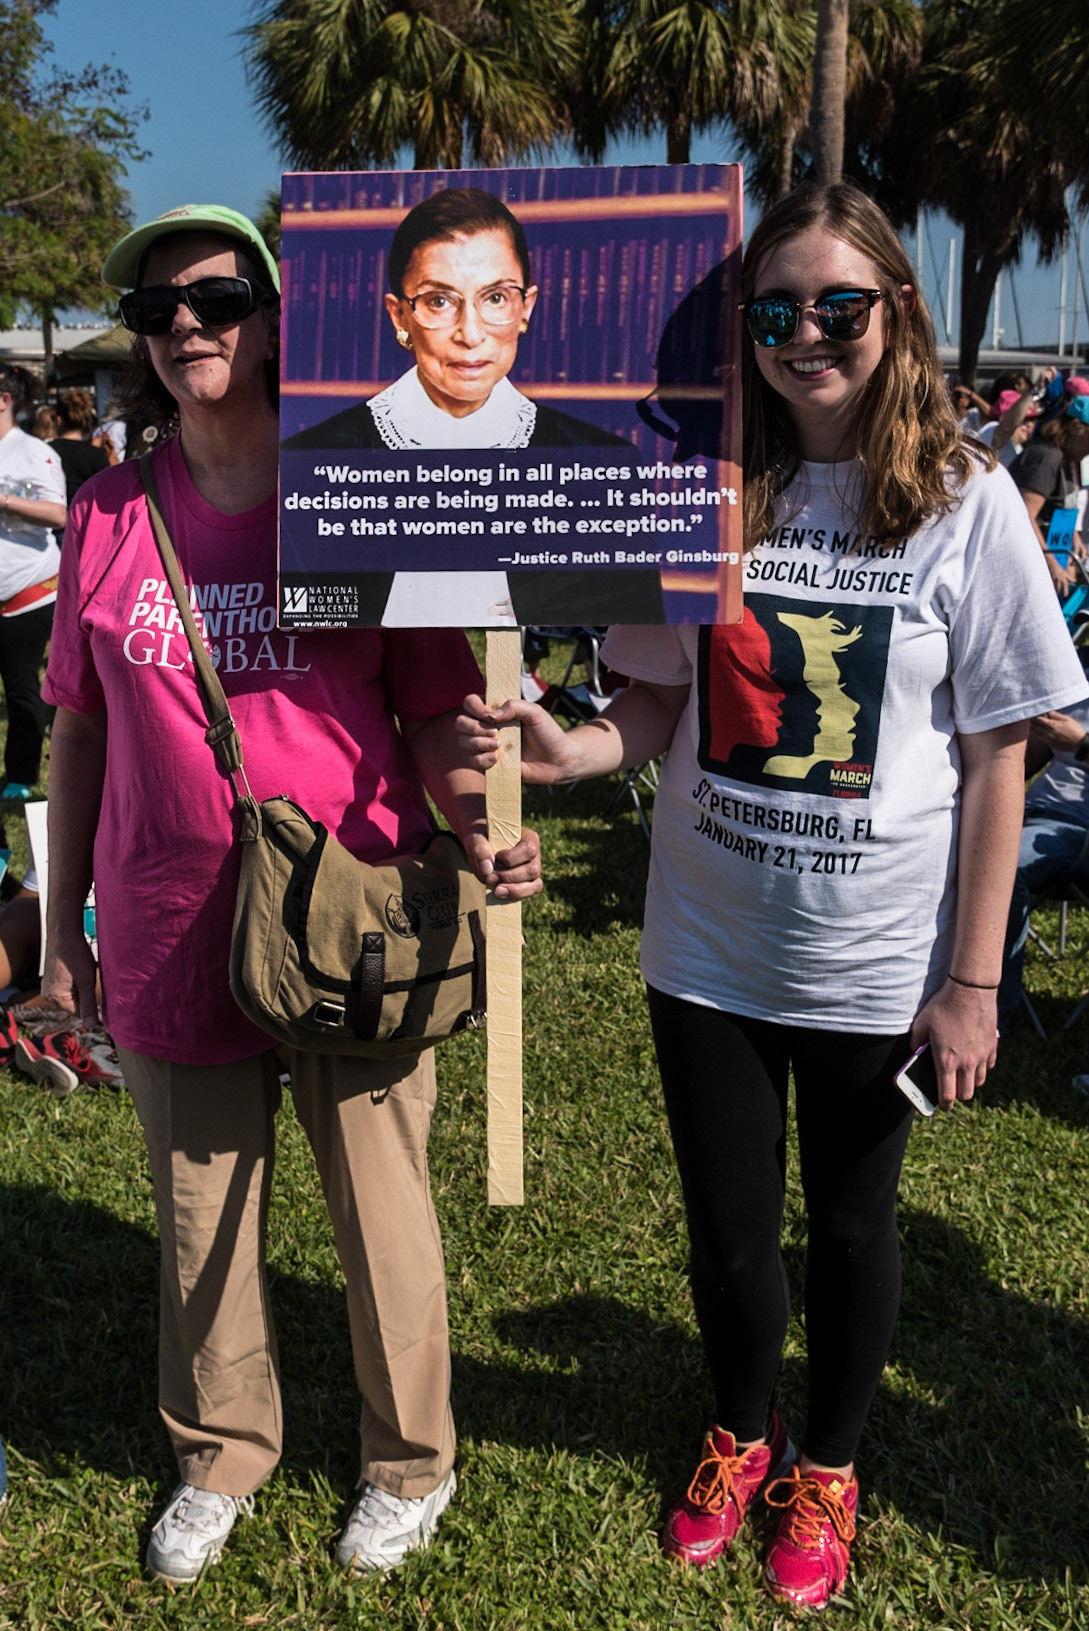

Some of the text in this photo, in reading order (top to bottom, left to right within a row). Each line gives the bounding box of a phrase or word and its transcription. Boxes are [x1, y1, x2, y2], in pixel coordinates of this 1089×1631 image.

[313, 462, 707, 486] “Women belong in all places where
[284, 491, 389, 510] decisions
[394, 495, 430, 509] are
[436, 490, 499, 512] being
[505, 490, 574, 508] made.
[607, 489, 624, 507] It
[629, 487, 738, 506] shouldn’t
[317, 514, 703, 537] be that women are the exception.”
[572, 550, 610, 564] Ruth
[614, 550, 662, 564] Bader
[666, 549, 740, 566] Ginsburg
[746, 560, 914, 595] SOCIAL JUSTICE
[308, 586, 359, 595] NATIONAL
[308, 595, 359, 604] WOMEN'S
[293, 620, 348, 628] www.nwlc.org
[832, 761, 873, 774] WOMEN'S
[829, 769, 872, 785] MARCH
[832, 789, 862, 799] FLORIDA
[710, 792, 845, 843] PETERSBURG,
[853, 818, 876, 840] FL
[694, 811, 862, 875] JANUARY 21, 2017
